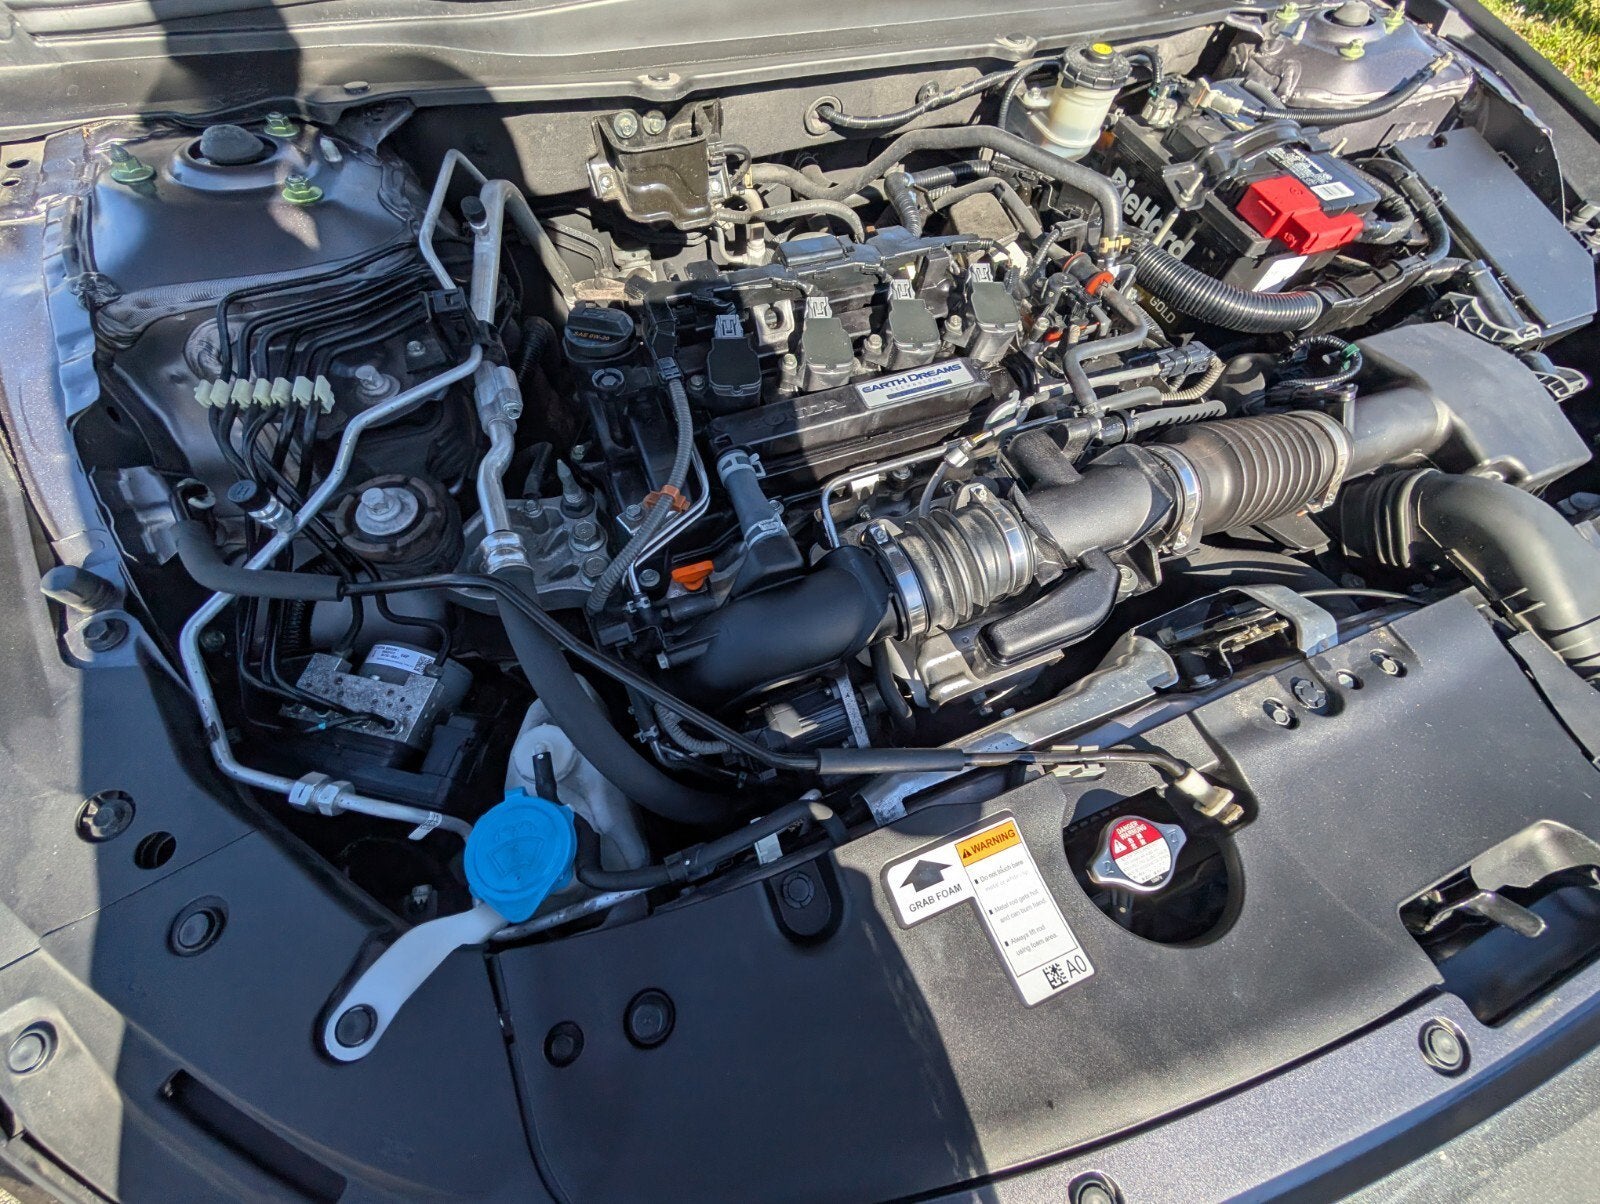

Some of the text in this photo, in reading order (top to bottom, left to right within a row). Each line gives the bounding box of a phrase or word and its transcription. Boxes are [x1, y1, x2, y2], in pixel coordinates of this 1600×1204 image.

[1150, 296, 1176, 324] GOLD
[862, 364, 962, 393] EARTH DREAMS
[1116, 820, 1139, 834] DANGER
[971, 829, 1016, 853] WARNING
[980, 873, 989, 882] Do
[988, 871, 998, 879] not
[908, 883, 963, 912] GRAB FOAM
[1010, 930, 1030, 944] Always
[1016, 944, 1031, 956] using
[1030, 938, 1045, 949] foam
